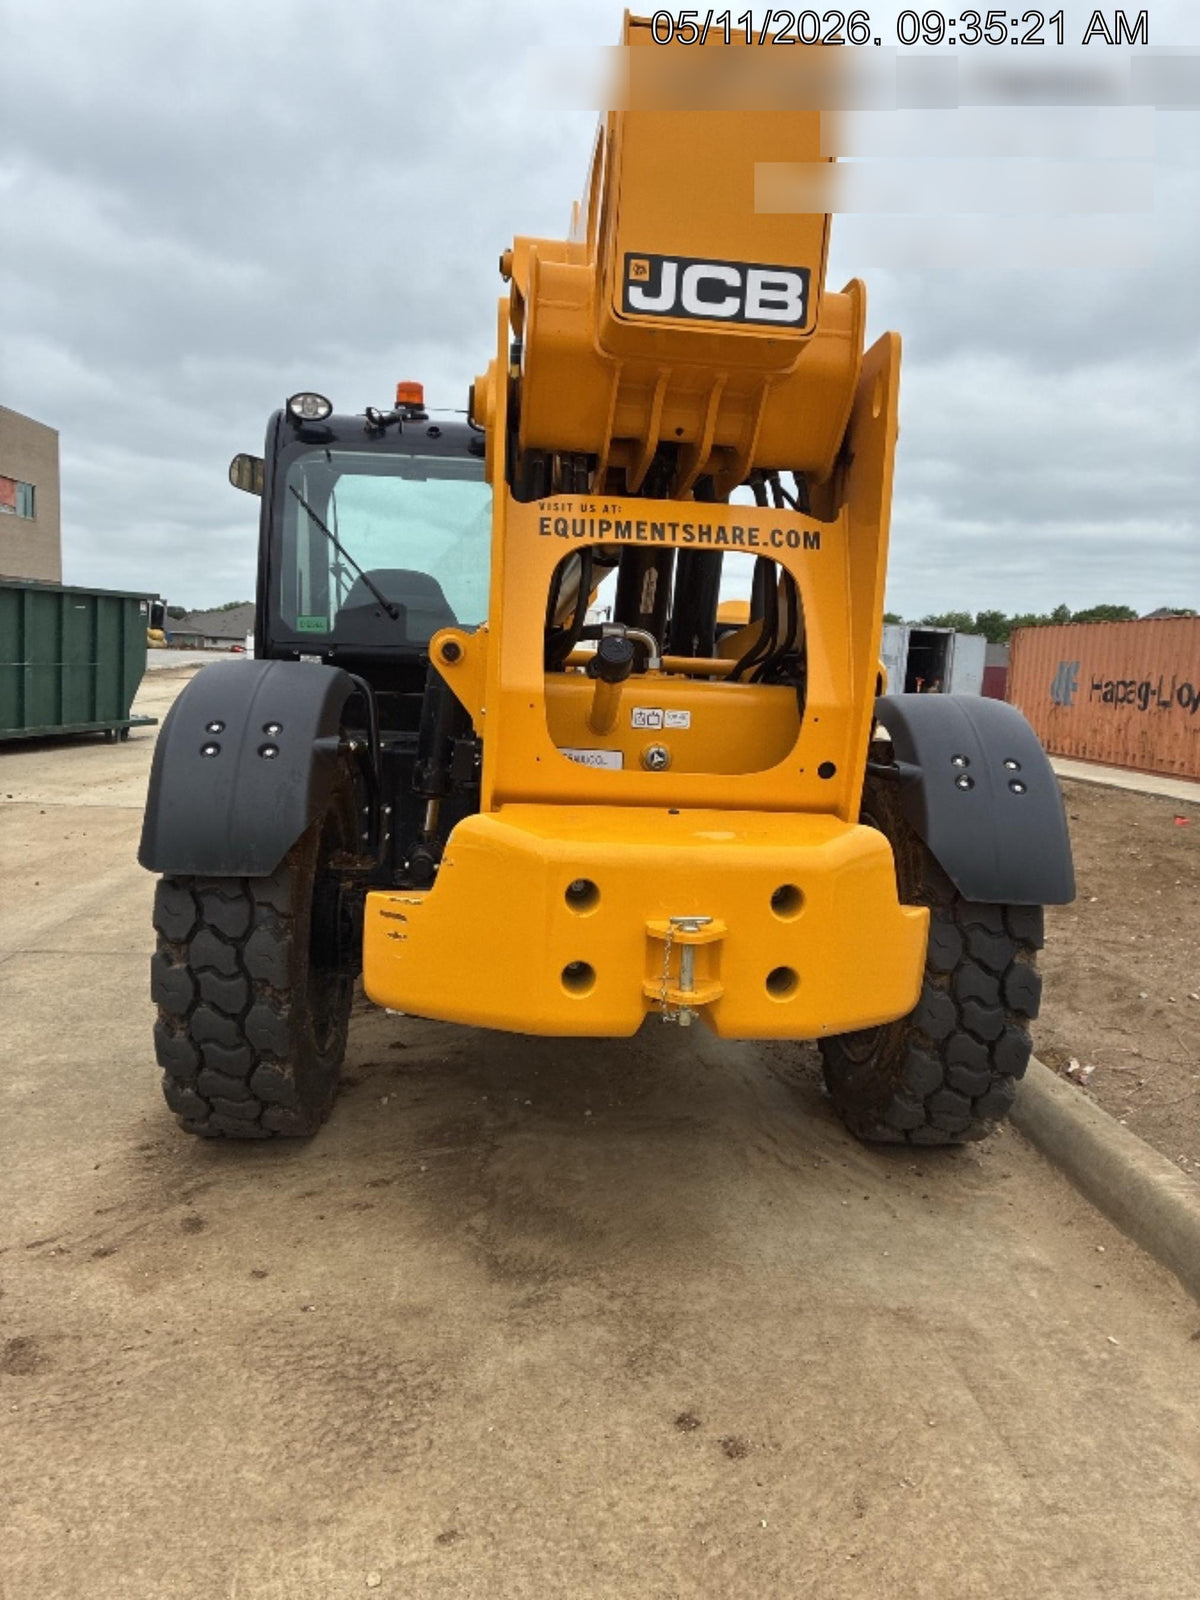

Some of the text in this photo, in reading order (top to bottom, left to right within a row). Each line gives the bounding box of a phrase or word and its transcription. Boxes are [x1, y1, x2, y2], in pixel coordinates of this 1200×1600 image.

[628, 261, 803, 322] JCB
[538, 502, 622, 514] VISIT US AT:
[539, 517, 821, 550] EQUIPMENTSHARE.COM
